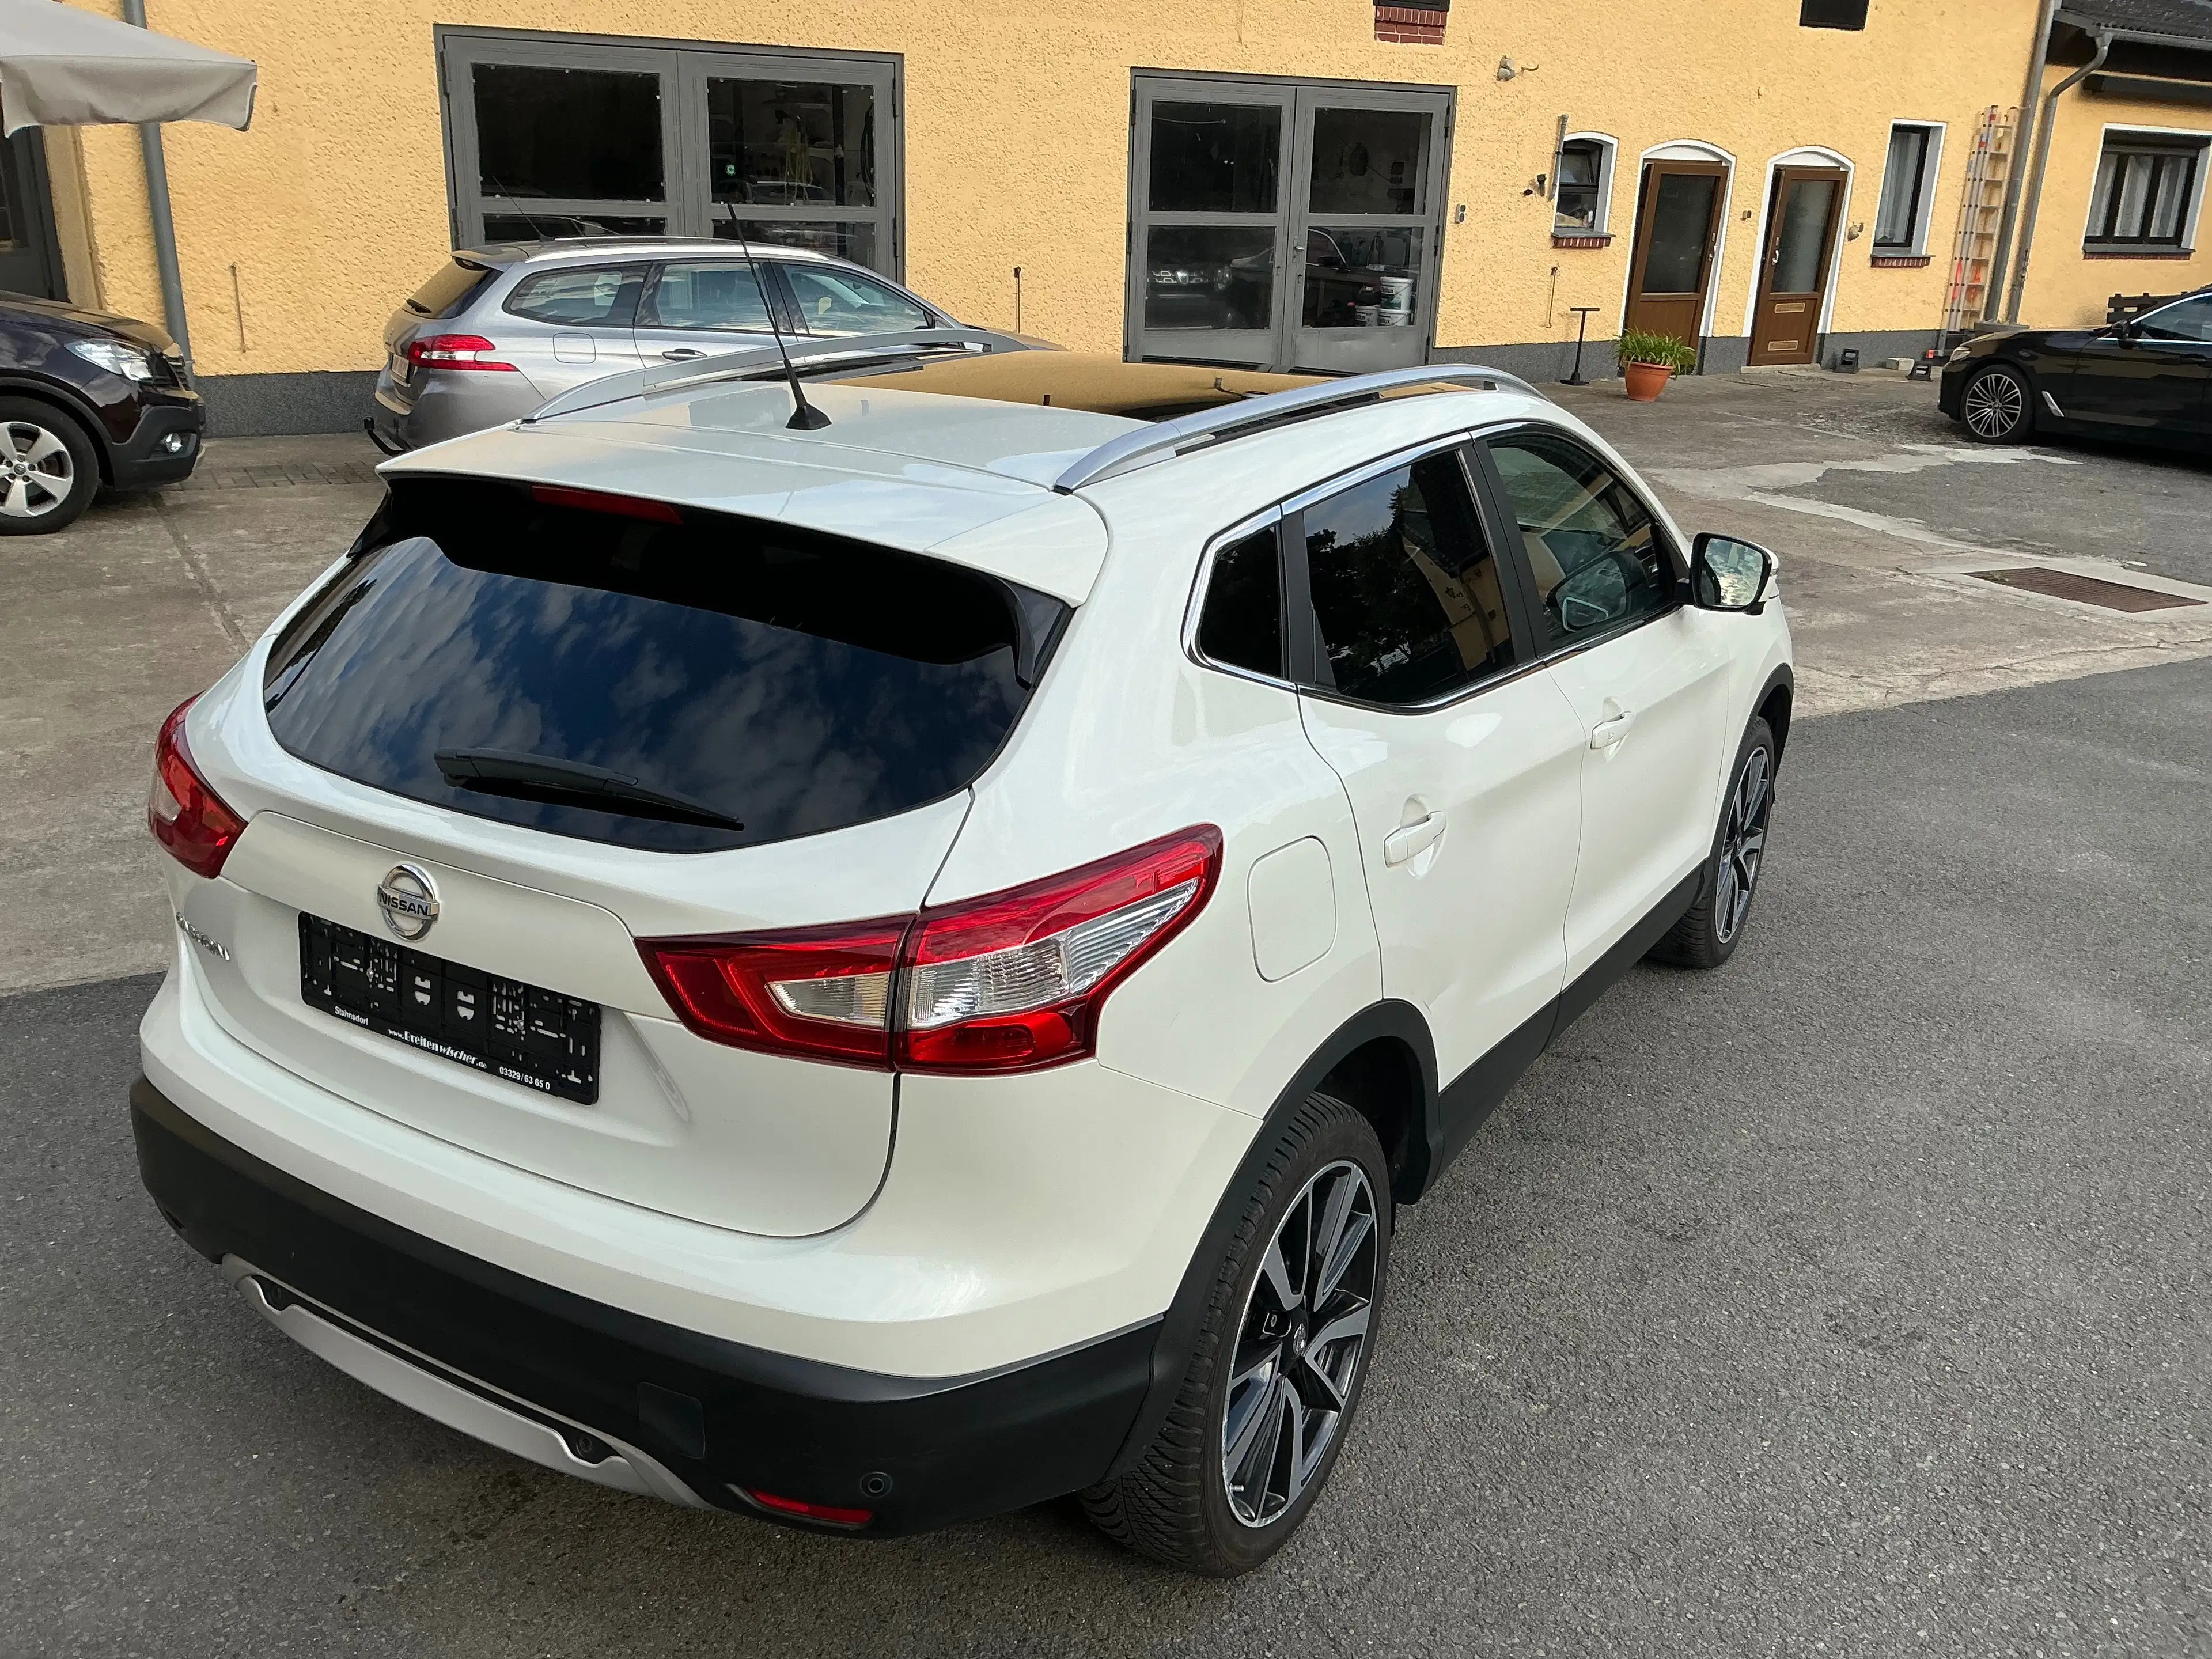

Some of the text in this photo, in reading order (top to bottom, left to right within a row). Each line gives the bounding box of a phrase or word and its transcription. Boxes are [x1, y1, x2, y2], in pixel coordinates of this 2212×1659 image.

[380, 892, 429, 916] NISSAN
[335, 1006, 369, 1025] Stahnsdorf
[388, 1028, 487, 1069] www.Breitenwischer.de
[499, 1066, 550, 1090] 03329/63 65 0
